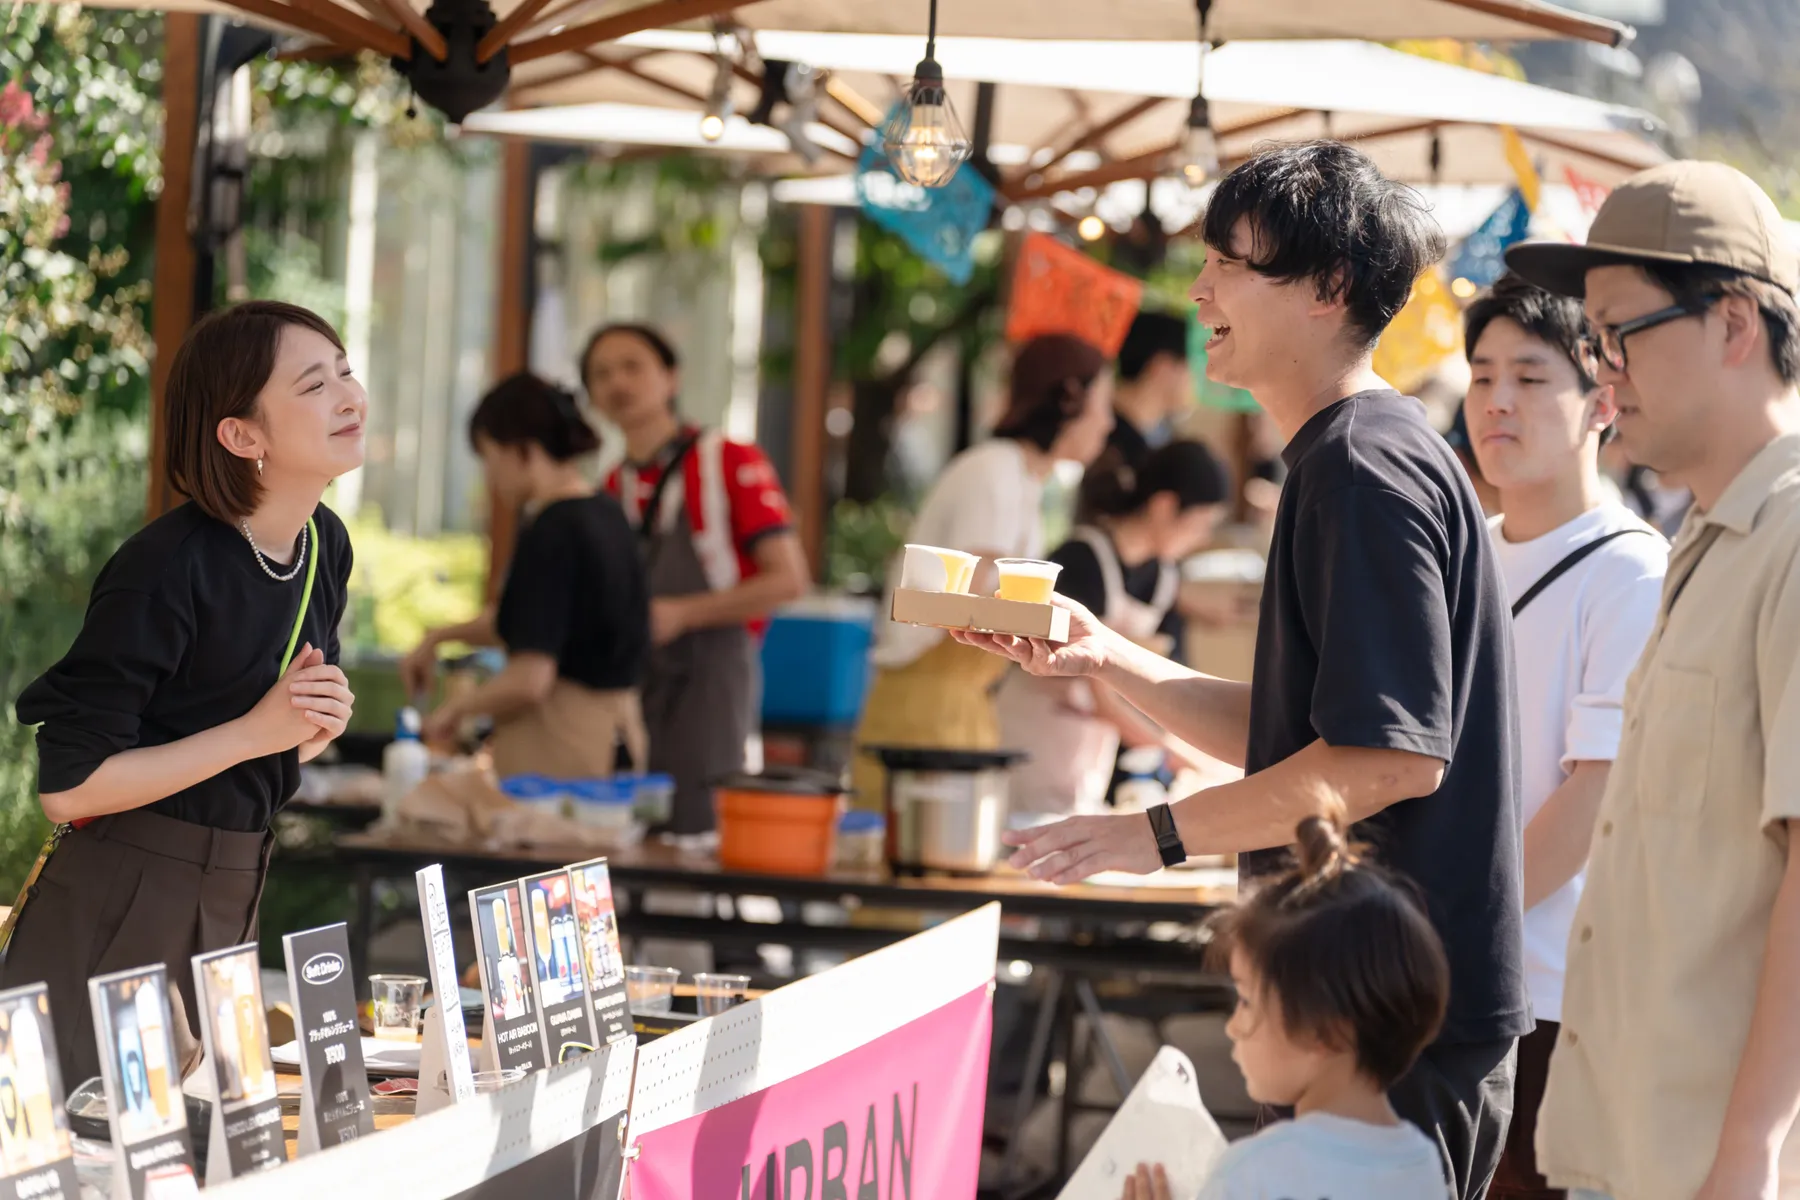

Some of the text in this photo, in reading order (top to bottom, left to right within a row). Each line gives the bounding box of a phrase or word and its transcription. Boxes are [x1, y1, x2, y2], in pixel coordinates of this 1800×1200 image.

[497, 1021, 538, 1044] HOT AIR BABOON
